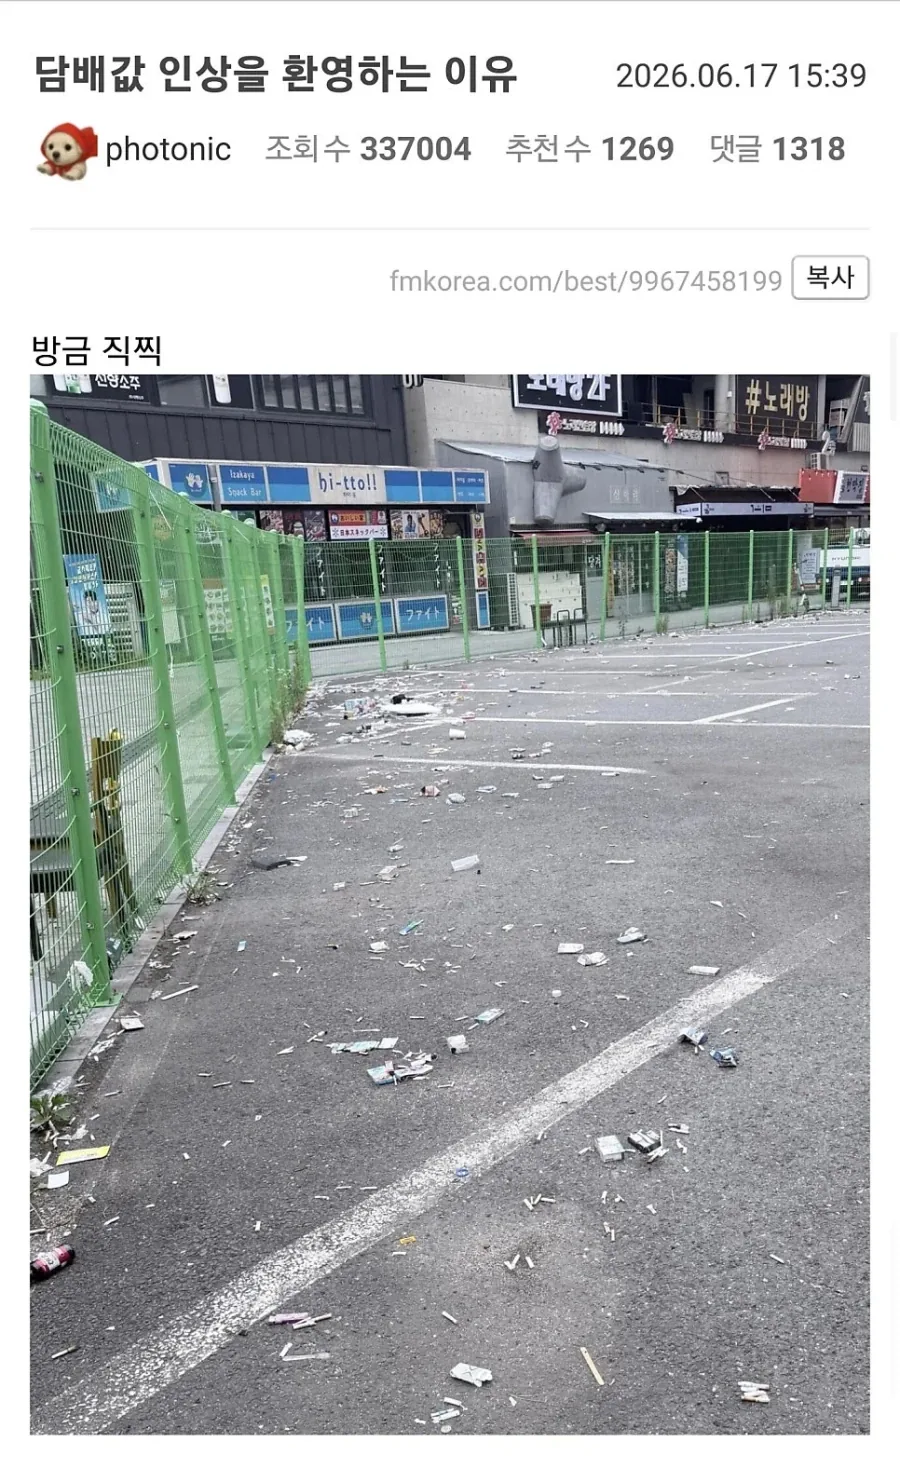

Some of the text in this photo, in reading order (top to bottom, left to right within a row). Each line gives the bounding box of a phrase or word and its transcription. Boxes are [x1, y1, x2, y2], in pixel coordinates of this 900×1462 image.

[745, 379, 810, 421] #노래방
[230, 469, 255, 481] Izakaya
[318, 473, 377, 492] hi-tto!!
[251, 488, 262, 497] Bar
[285, 616, 325, 633] フイト
